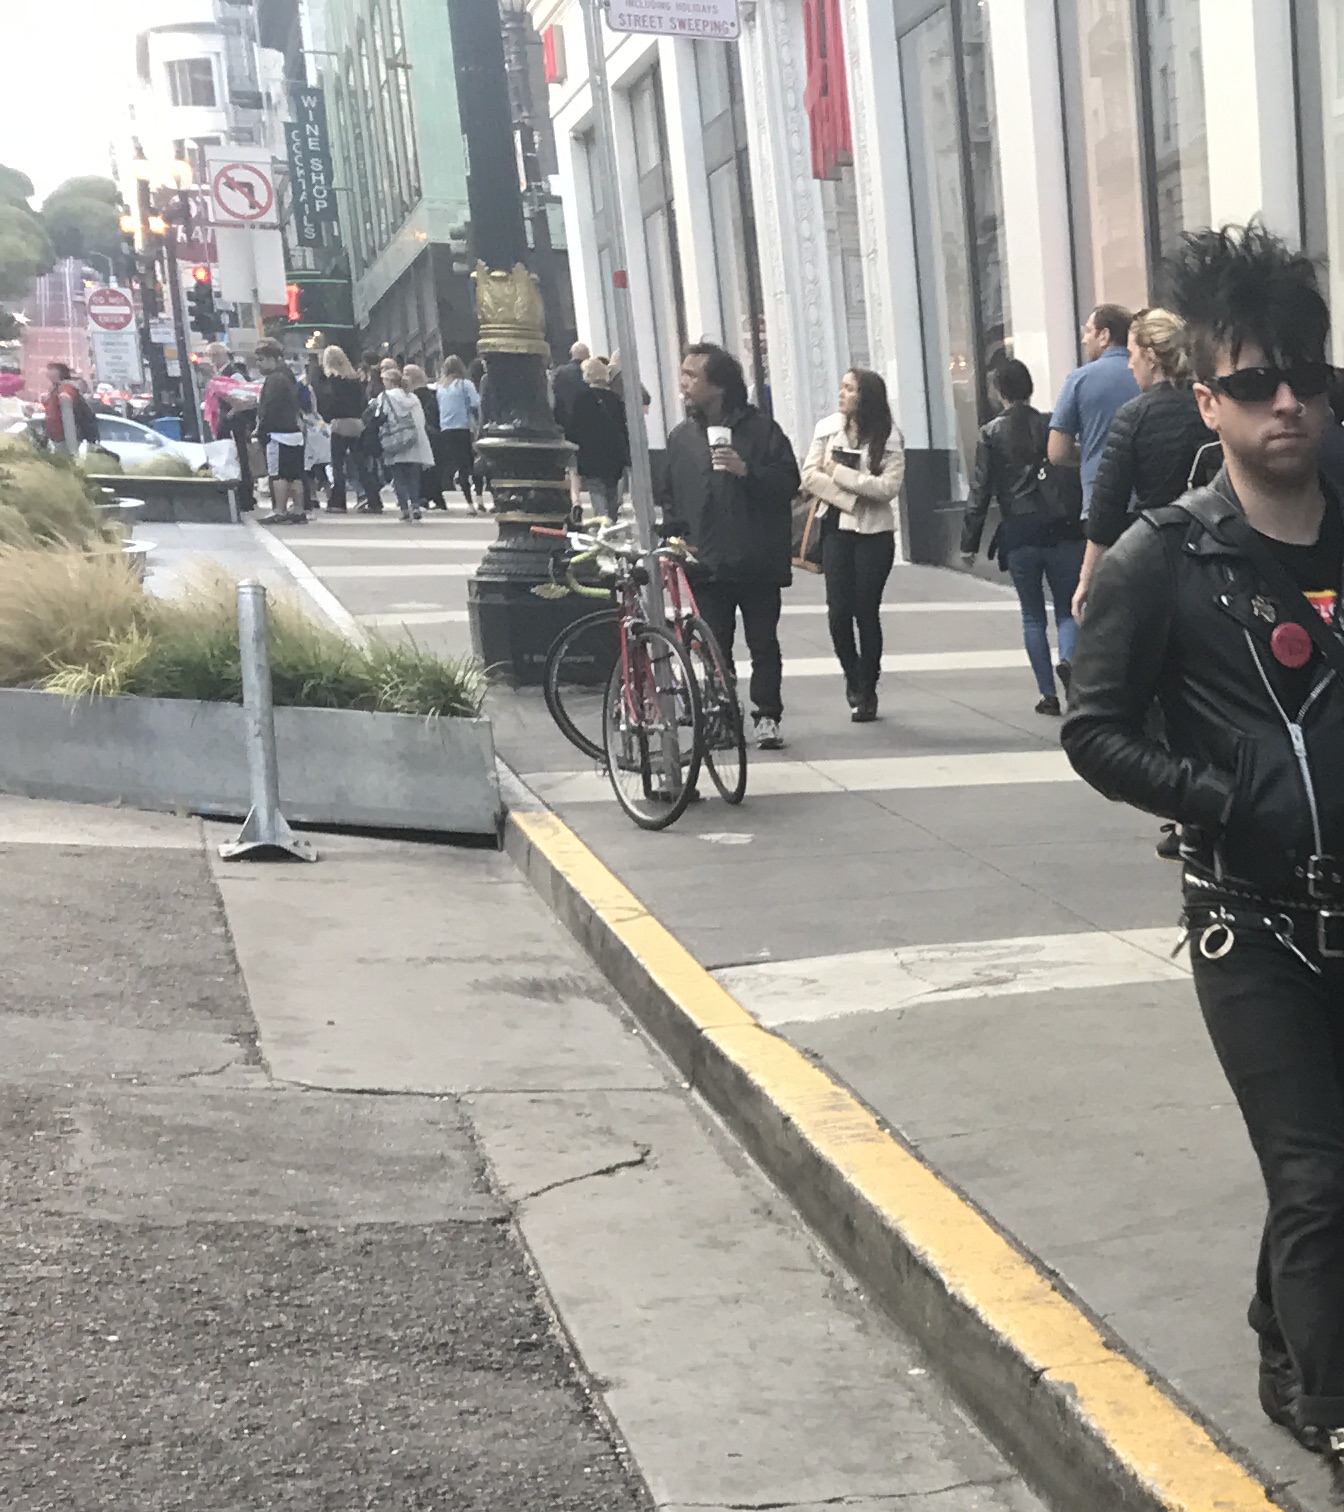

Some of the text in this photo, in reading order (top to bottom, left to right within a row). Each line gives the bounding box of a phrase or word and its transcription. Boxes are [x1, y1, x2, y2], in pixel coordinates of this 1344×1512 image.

[618, 12, 729, 34] STREET SWEEPING
[675, 2, 719, 14] HOLIDAYS
[291, 129, 317, 240] COCKTAILS
[300, 95, 328, 213] WINE SHOP
